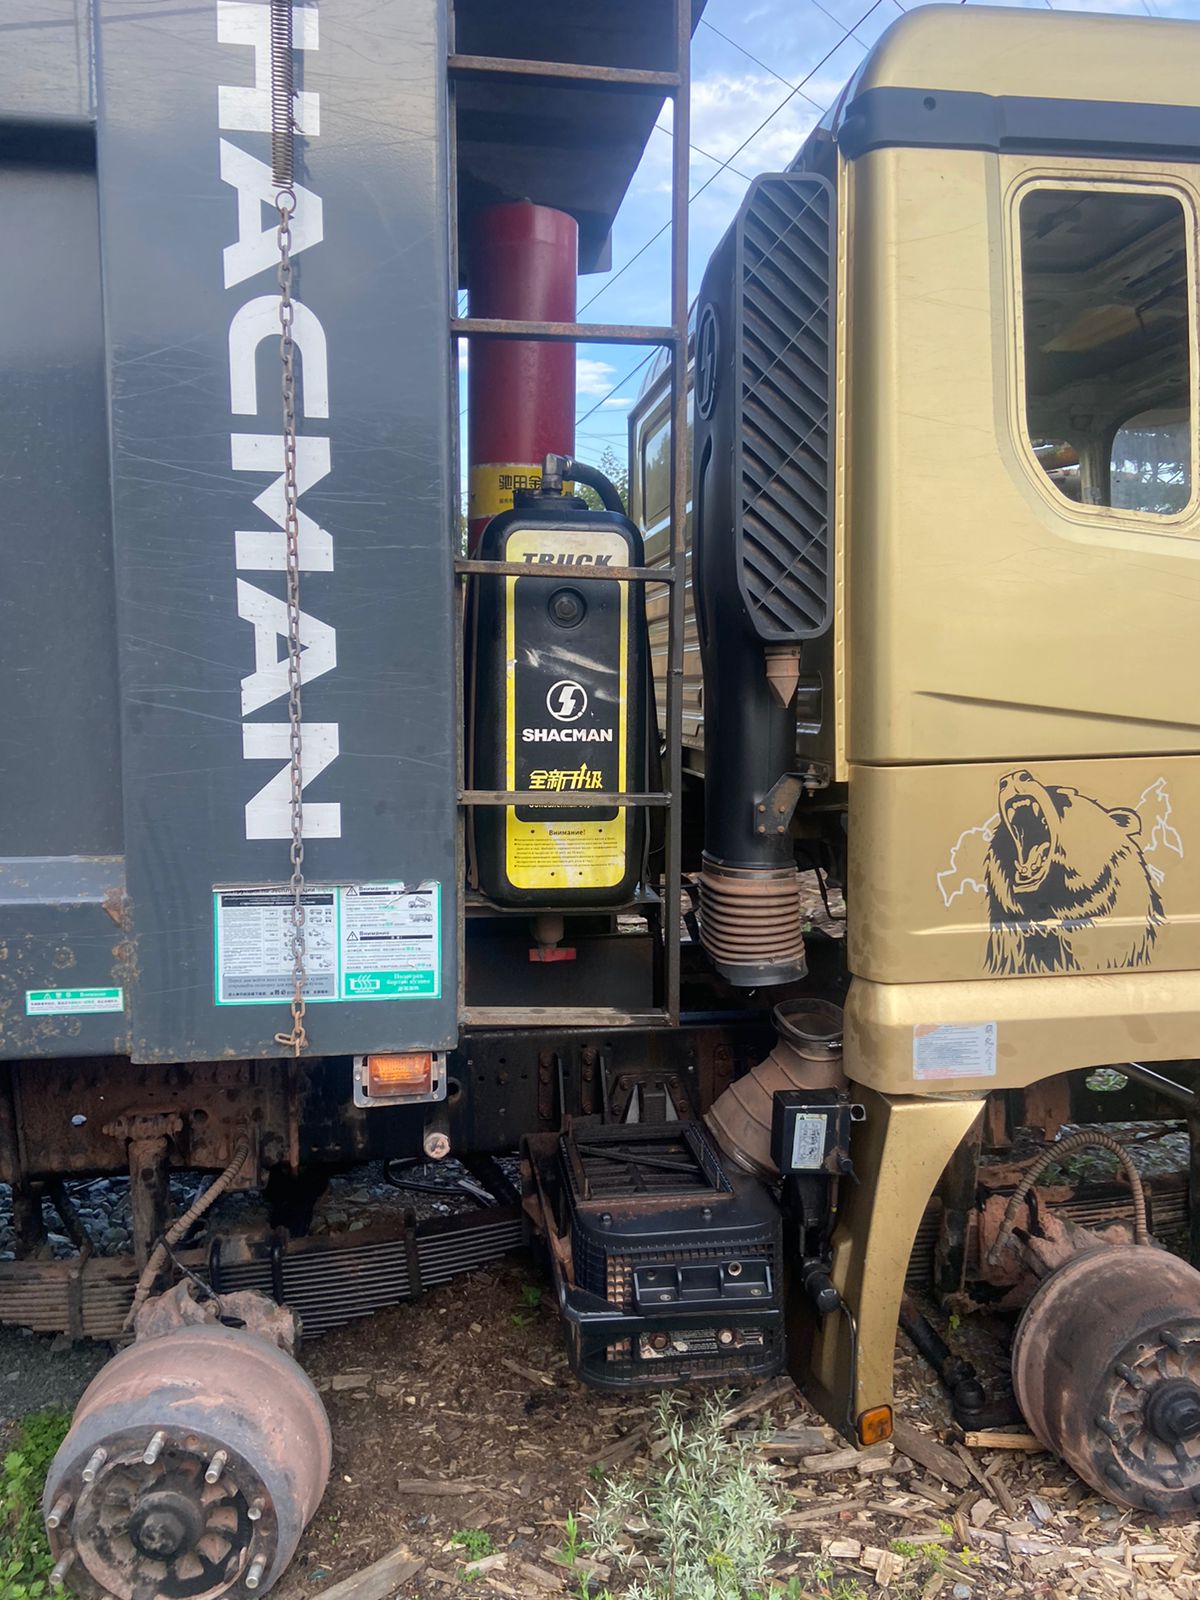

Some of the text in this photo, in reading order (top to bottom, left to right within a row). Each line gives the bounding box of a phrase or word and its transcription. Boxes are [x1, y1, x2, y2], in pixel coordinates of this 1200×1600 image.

[522, 728, 613, 742] SHACMAN
[528, 762, 604, 792] 全新升级
